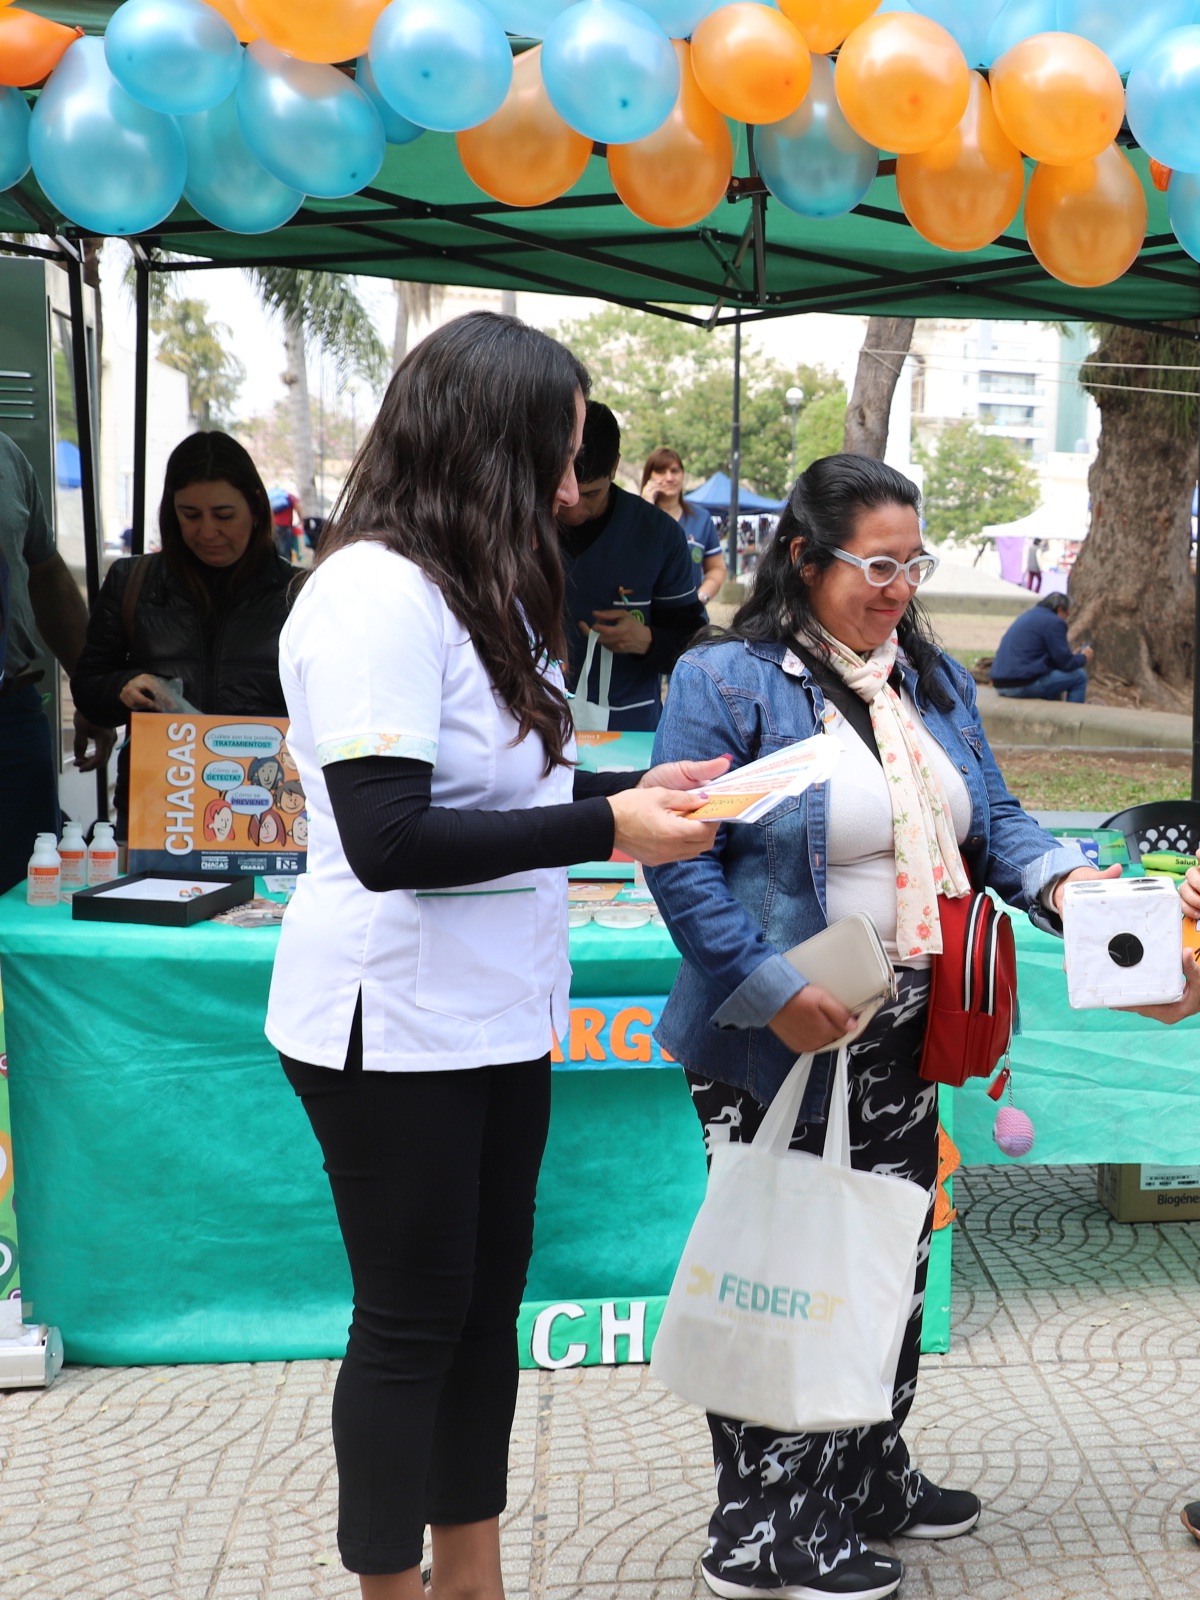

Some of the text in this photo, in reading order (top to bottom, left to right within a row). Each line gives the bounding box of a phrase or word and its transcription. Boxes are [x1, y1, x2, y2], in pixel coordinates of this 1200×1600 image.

[214, 740, 272, 748] TRATAMIENTOS?
[165, 722, 197, 856] CHAGAS
[231, 798, 269, 806] PREVIENE?
[201, 861, 229, 869] CHAGAS
[1175, 858, 1196, 866] Salud
